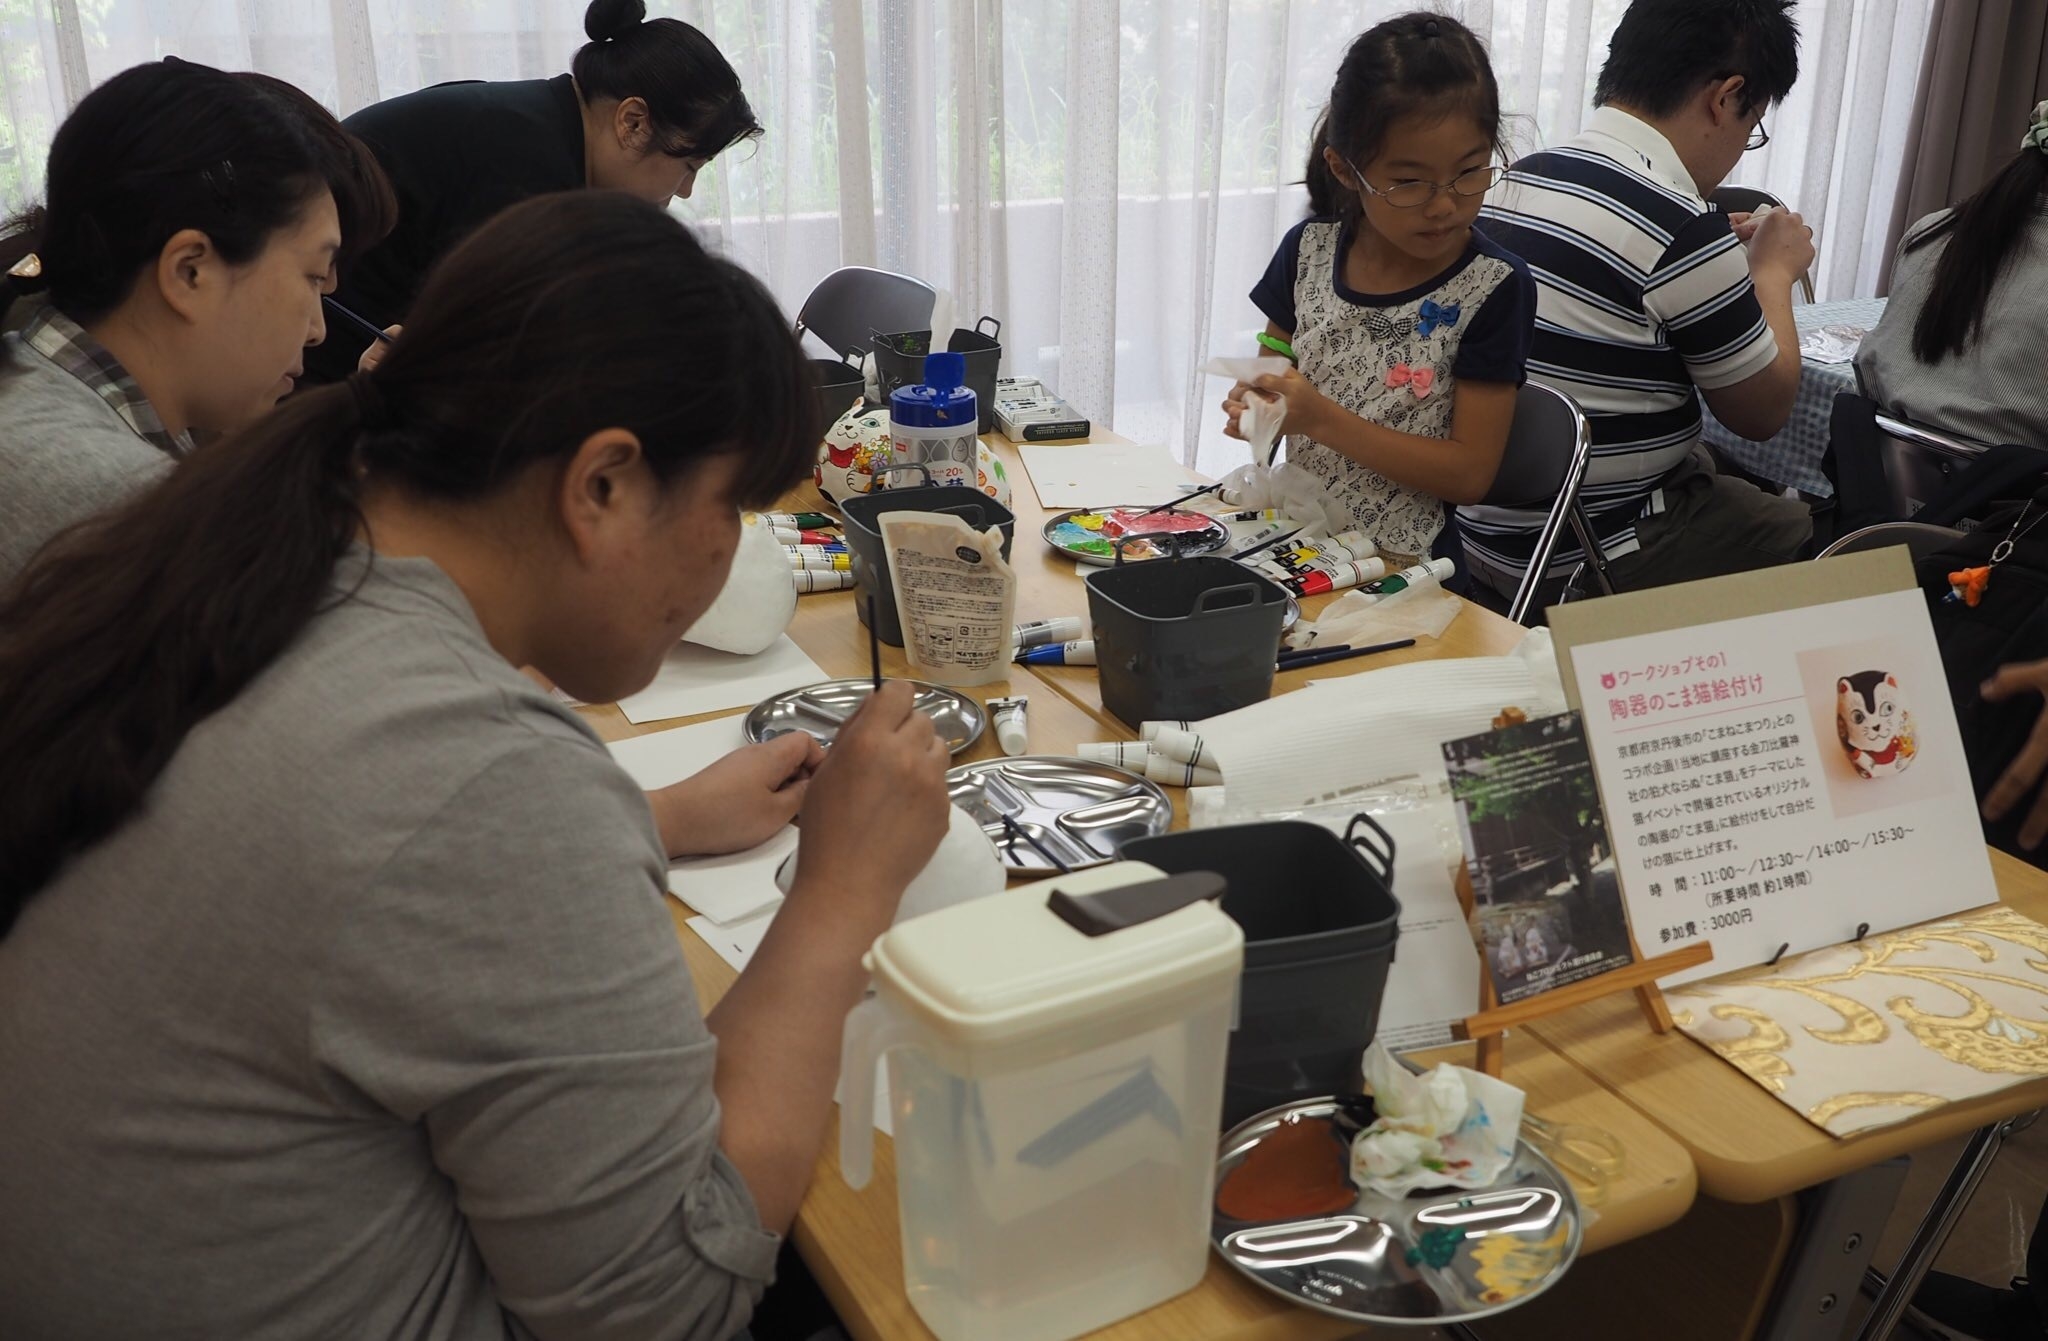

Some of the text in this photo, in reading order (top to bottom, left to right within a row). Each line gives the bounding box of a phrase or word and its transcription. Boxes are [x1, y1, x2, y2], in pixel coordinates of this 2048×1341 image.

[1609, 673, 1764, 721] 陶器のこま猫絵付け
[1617, 713, 1795, 760] 京都府京丹後市の「こまねこまつり」との
[1632, 778, 1811, 827] 猫イベントで開催されているオリジナル
[1643, 840, 1738, 870] けの猫に仕上げます。
